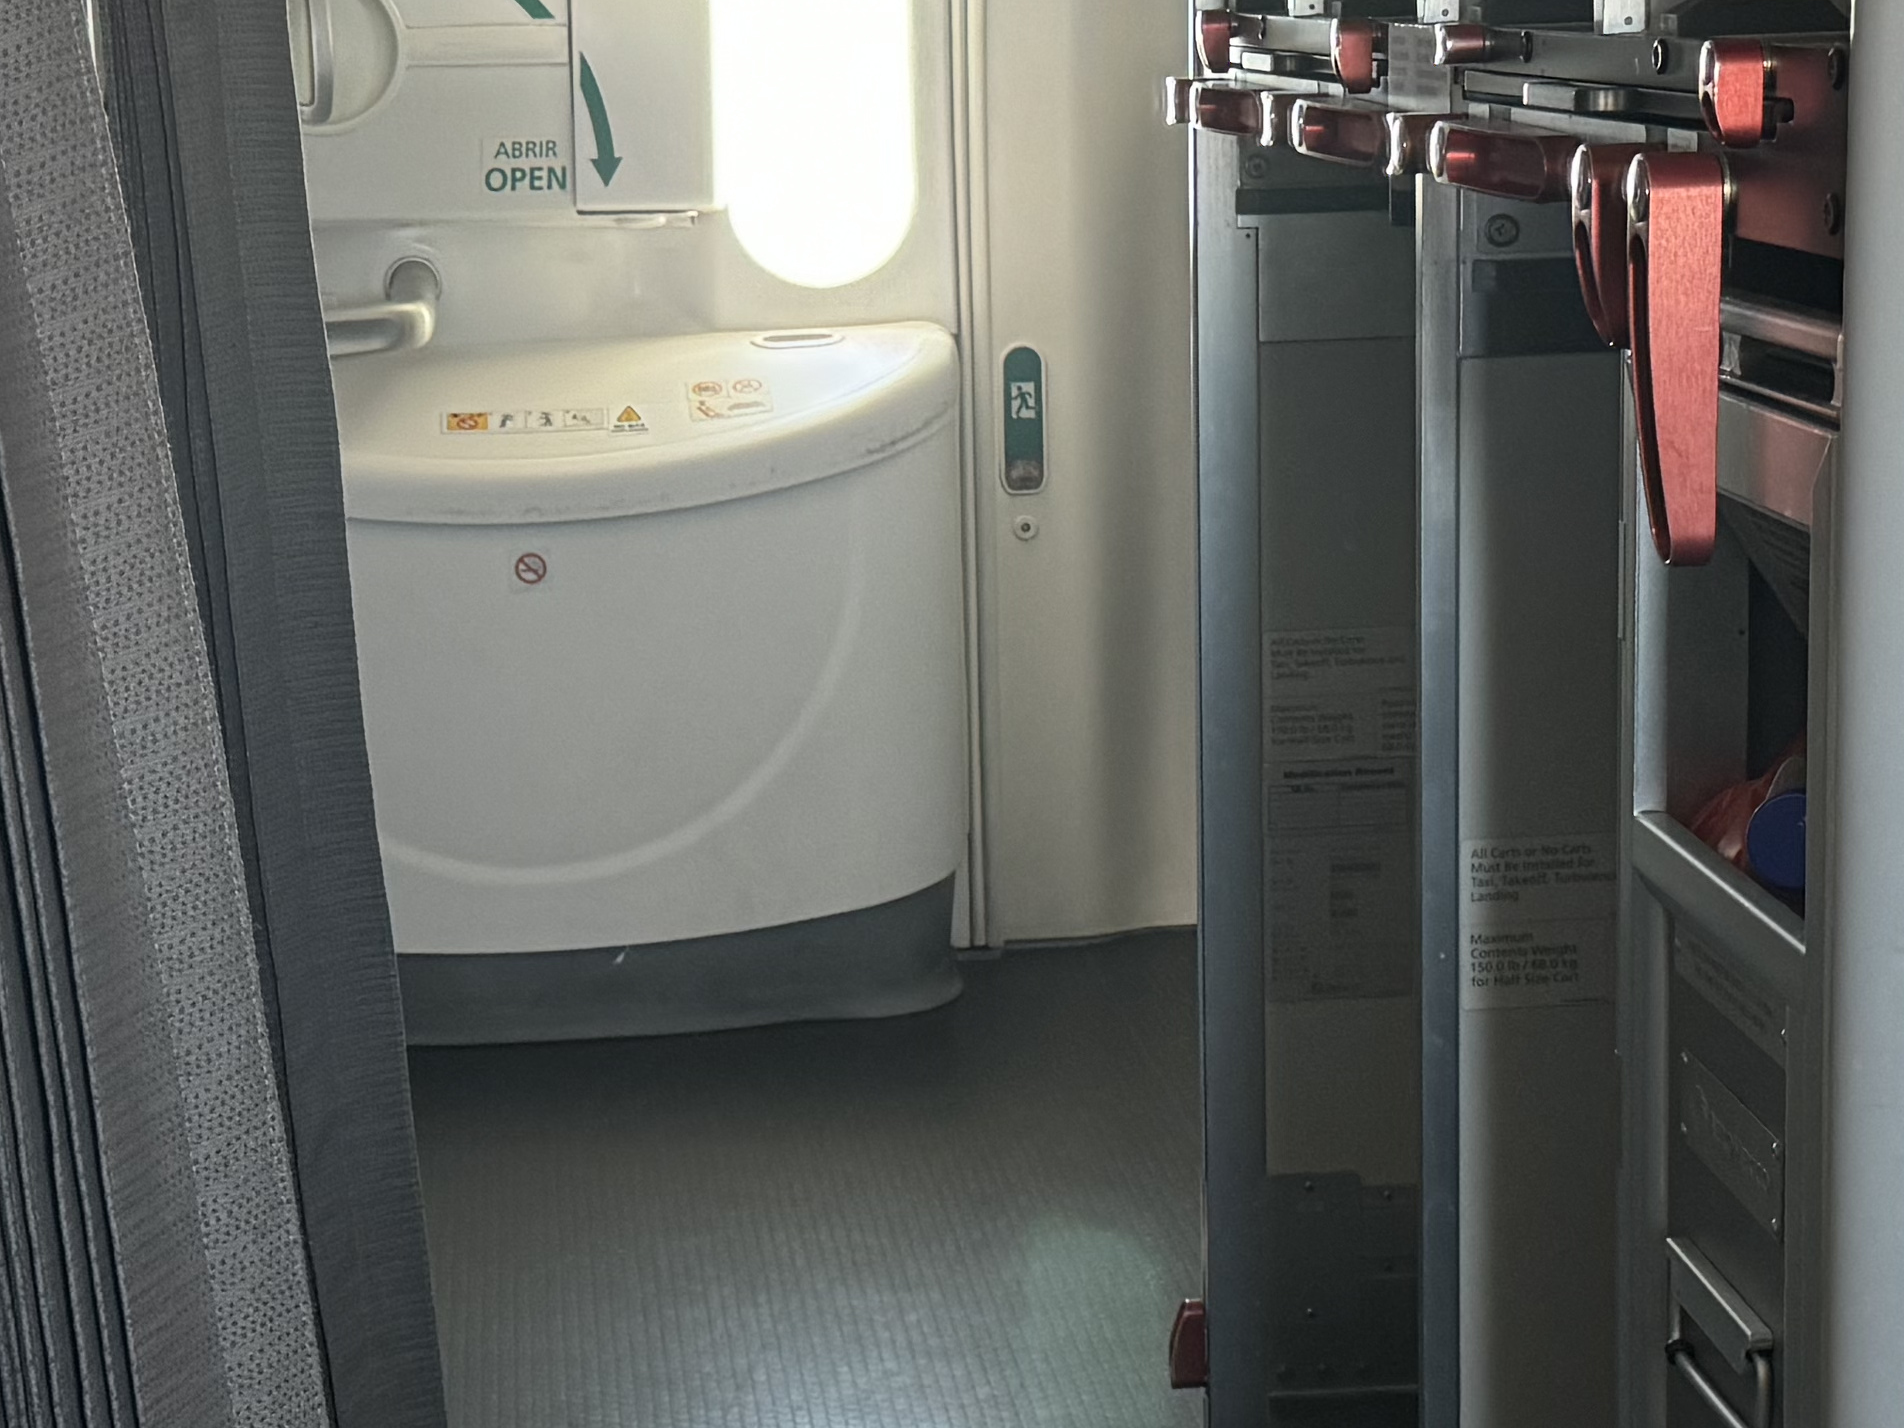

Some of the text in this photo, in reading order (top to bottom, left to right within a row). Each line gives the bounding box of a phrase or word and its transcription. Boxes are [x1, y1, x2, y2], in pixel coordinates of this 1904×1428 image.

[494, 139, 558, 159] ABRIR
[484, 165, 567, 193] OPEN
[1471, 847, 1487, 859] All
[1525, 848, 1537, 856] or
[1471, 863, 1500, 873] Must
[1471, 933, 1533, 945] Maximum
[1472, 977, 1489, 987] for
